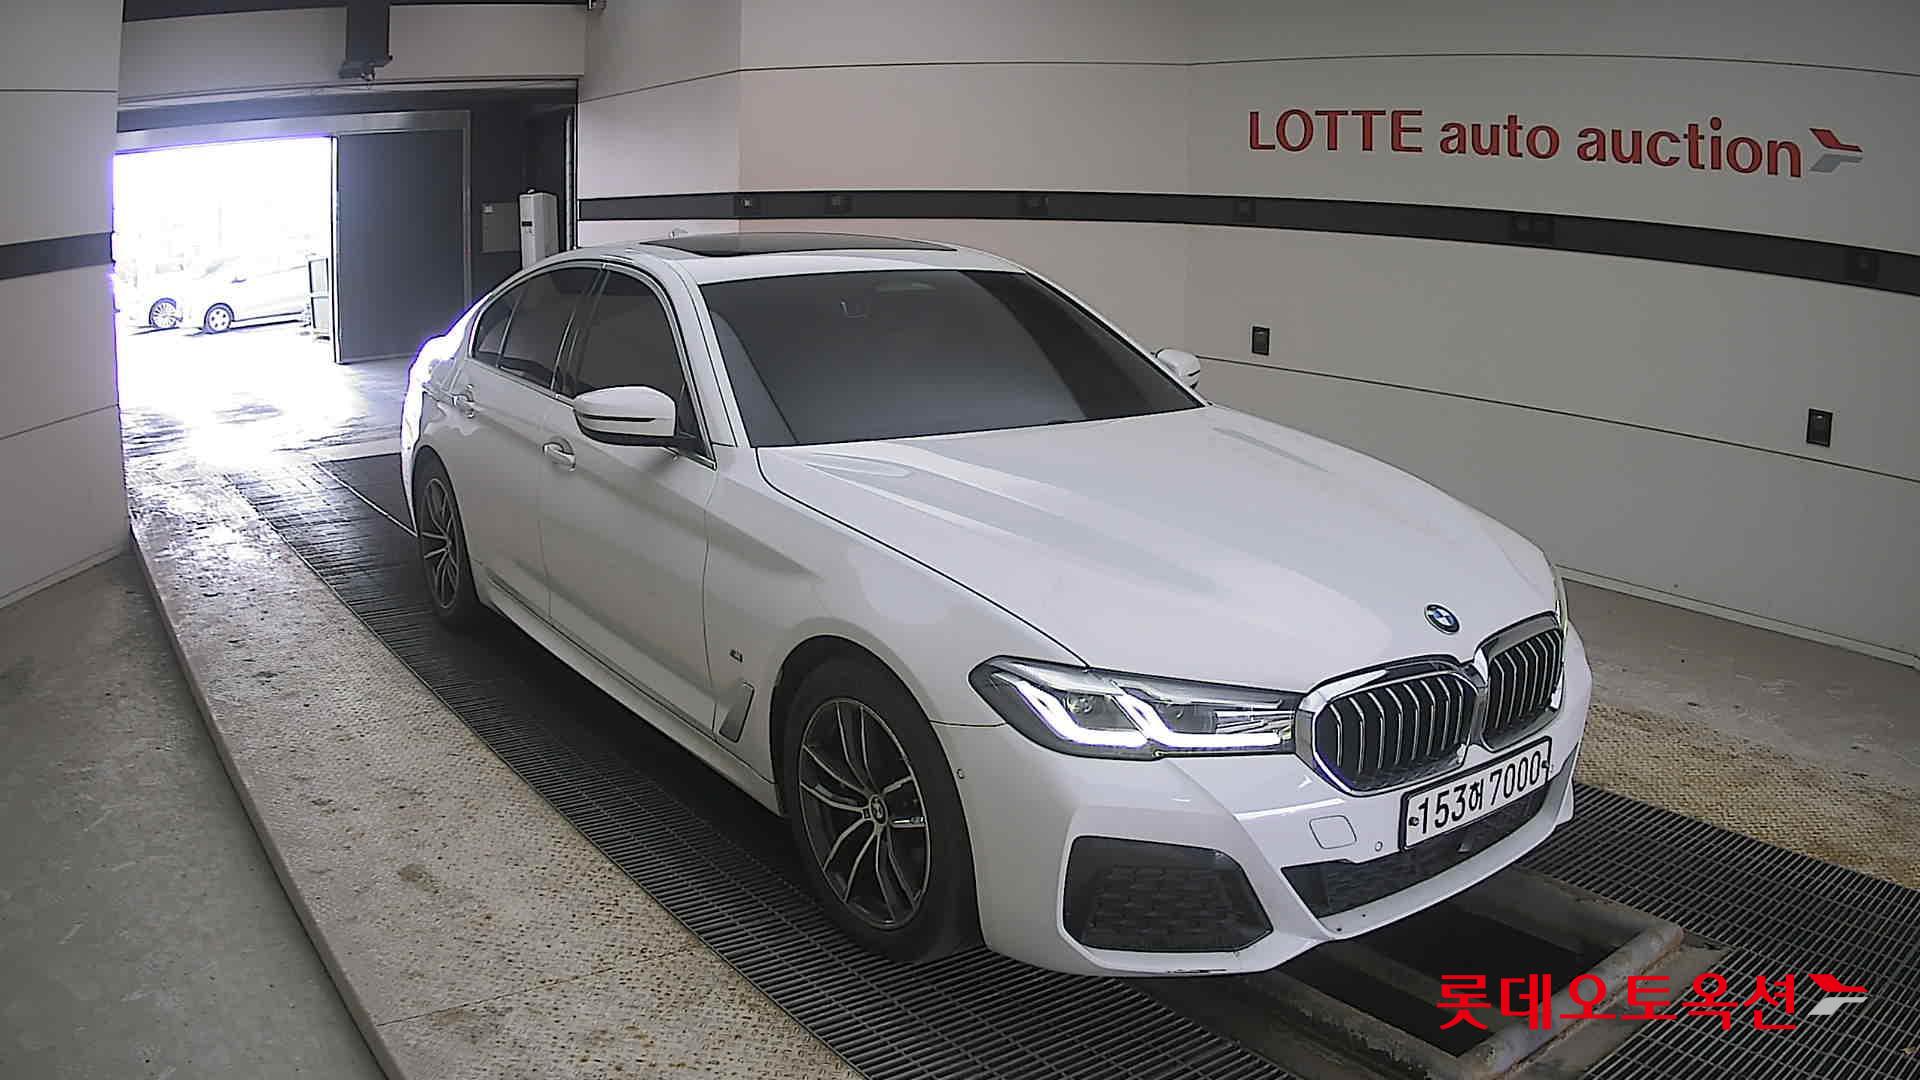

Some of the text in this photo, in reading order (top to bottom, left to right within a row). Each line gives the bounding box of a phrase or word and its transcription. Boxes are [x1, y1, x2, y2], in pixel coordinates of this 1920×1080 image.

[1249, 110, 1802, 178] LOTTE auto auction
[1489, 751, 1541, 805] 7000
